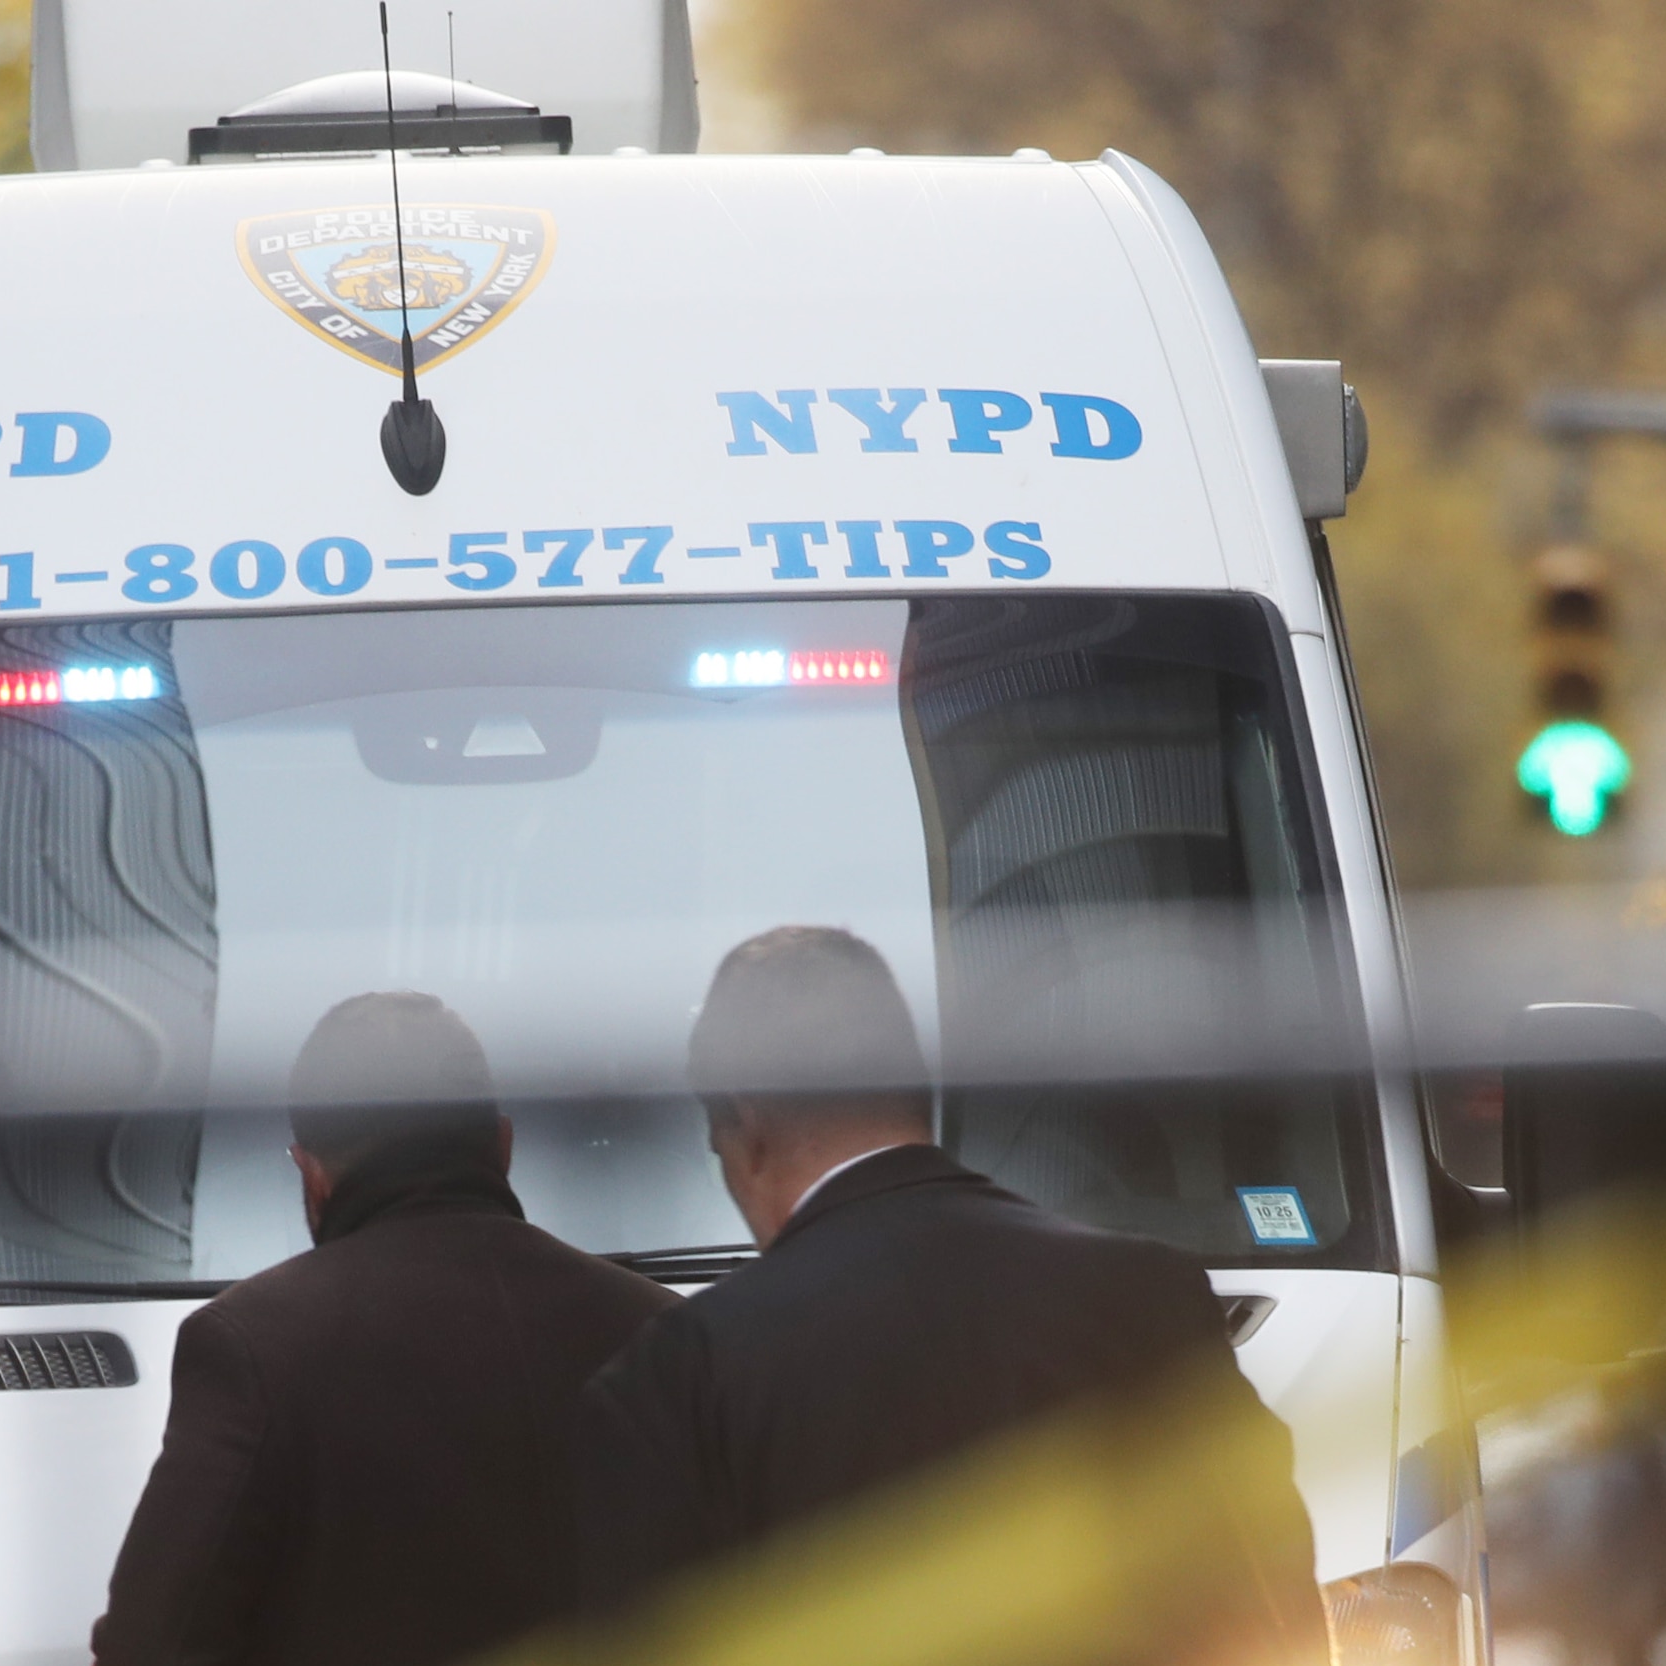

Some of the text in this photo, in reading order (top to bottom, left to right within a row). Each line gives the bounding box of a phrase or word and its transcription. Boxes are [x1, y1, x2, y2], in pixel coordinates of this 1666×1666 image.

[260, 222, 533, 254] DEPARTMENT
[315, 209, 476, 228] POLICE
[267, 270, 369, 341] CITY OF
[427, 251, 536, 349] NEW YORK
[715, 388, 1142, 461] NYPD
[1255, 1206, 1292, 1217] 10 25
